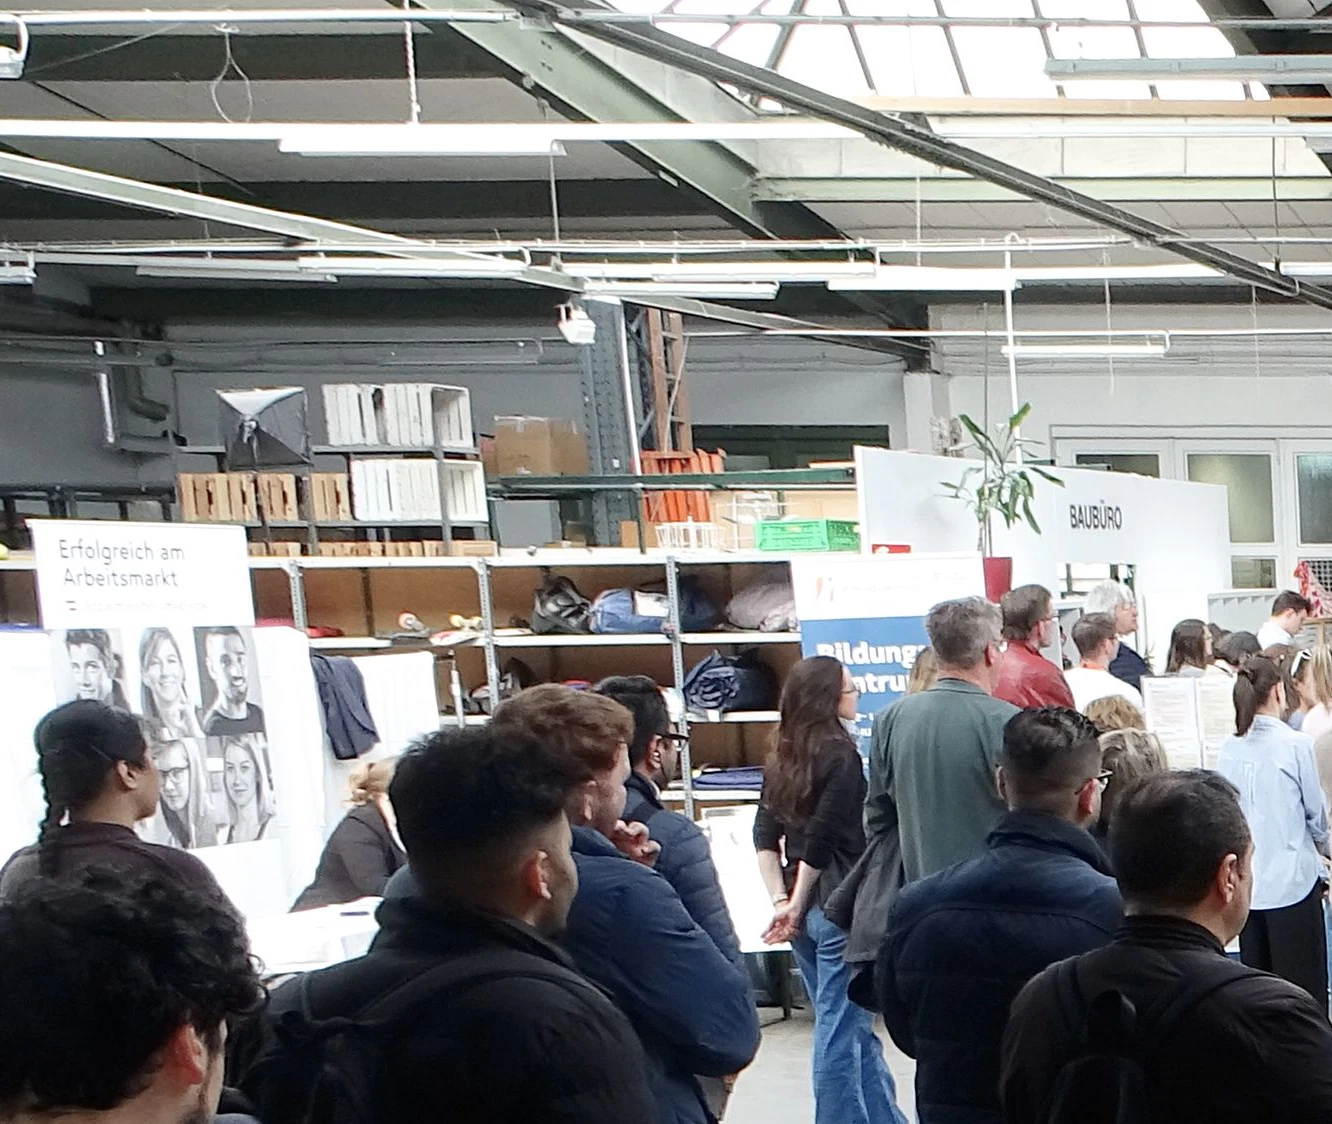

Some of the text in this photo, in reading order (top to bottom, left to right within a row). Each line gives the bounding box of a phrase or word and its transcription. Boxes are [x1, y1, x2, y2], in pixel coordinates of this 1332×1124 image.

[1069, 499, 1123, 530] BAUBÜRO
[59, 538, 185, 565] Erfolgreich am
[64, 567, 179, 587] Arbeitsmarkt
